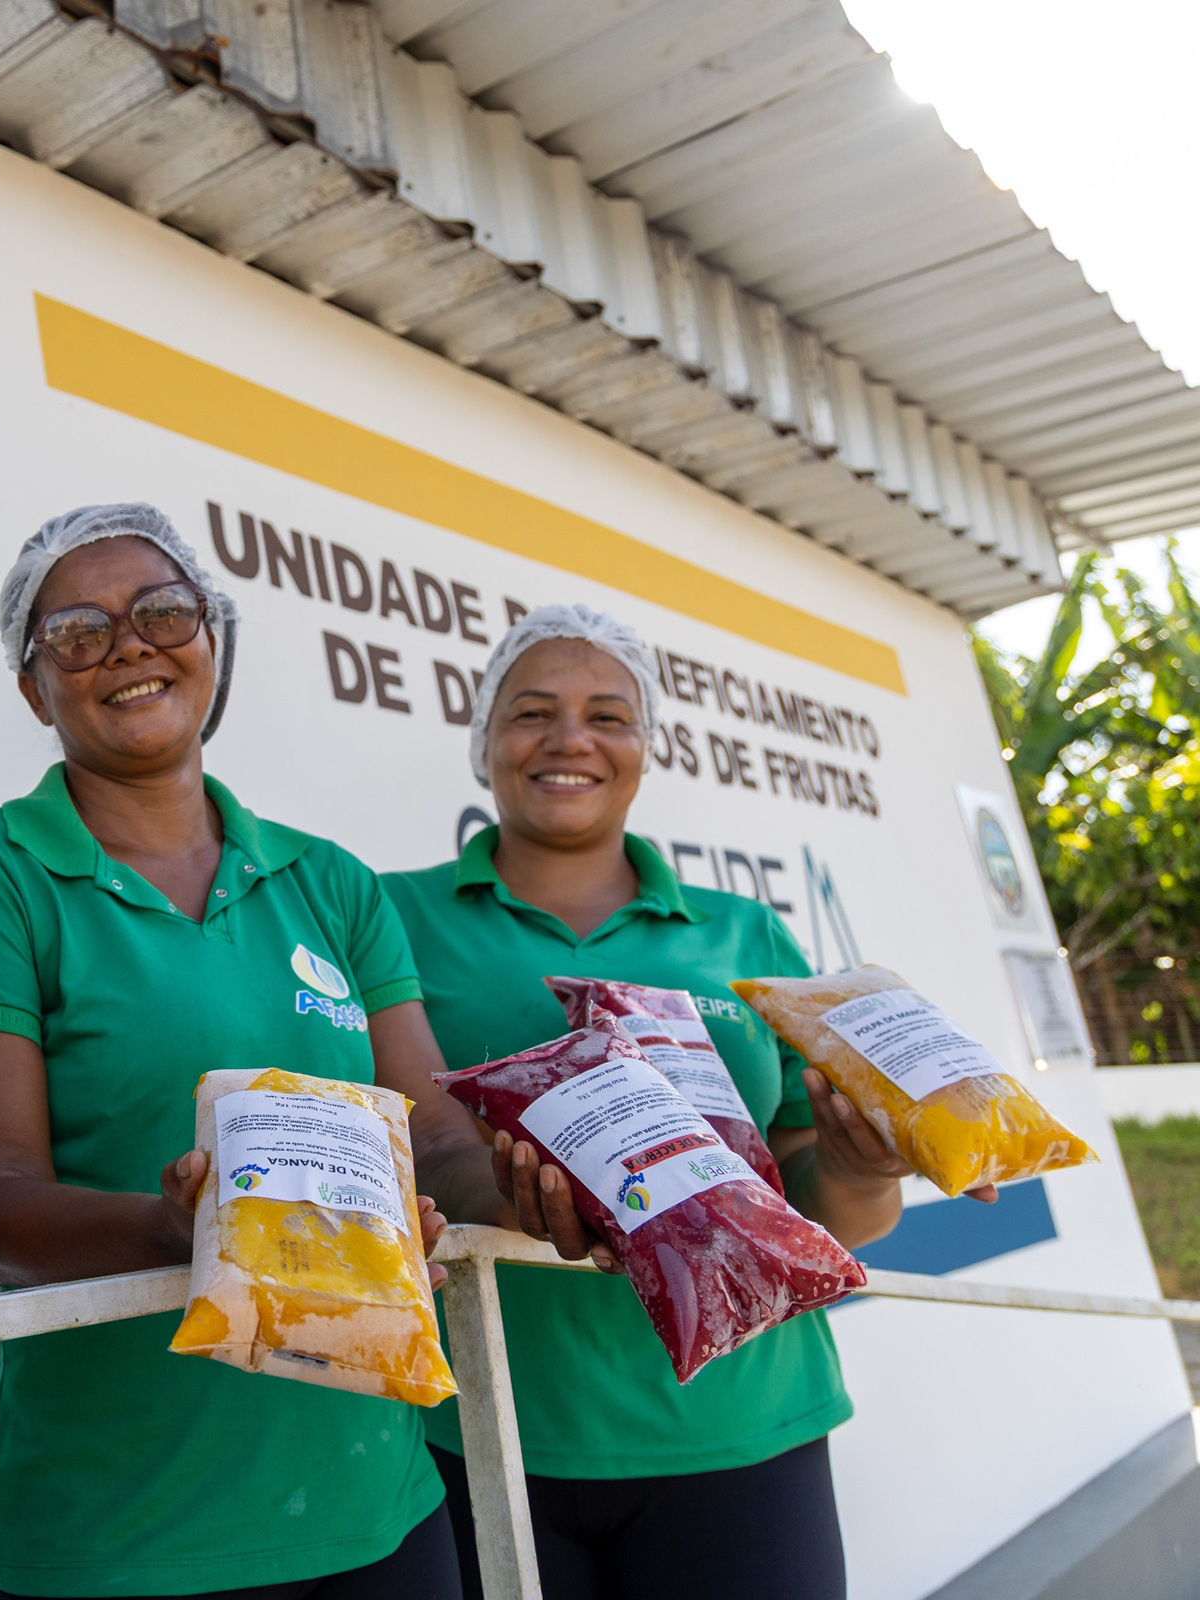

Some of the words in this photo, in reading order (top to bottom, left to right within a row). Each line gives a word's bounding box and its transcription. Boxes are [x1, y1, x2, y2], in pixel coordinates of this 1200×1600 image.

[206, 499, 488, 645] UNIDADE
[655, 645, 880, 758] NEFICIAMENTO
[322, 629, 411, 714] DE
[706, 731, 757, 790] DE
[763, 748, 878, 820] FRUTAS
[854, 1020, 883, 1036] POLPA
[883, 1014, 896, 1024] DE
[603, 1063, 624, 1073] MANTER
[610, 1076, 628, 1084] Peso
[576, 1092, 590, 1101] 1Kg
[571, 1109, 595, 1127] REGISTRO
[641, 1123, 661, 1134] MAPA
[574, 1124, 607, 1149] COOPERATIVA
[675, 1138, 694, 1148] DE
[305, 1143, 327, 1151] MAPA
[622, 1142, 676, 1169] ACEROLA
[267, 1157, 323, 1170] MANGA
[327, 1163, 346, 1173] DE
[618, 1172, 644, 1203] AFAGOS
[334, 1193, 403, 1226] COOPEIPE
